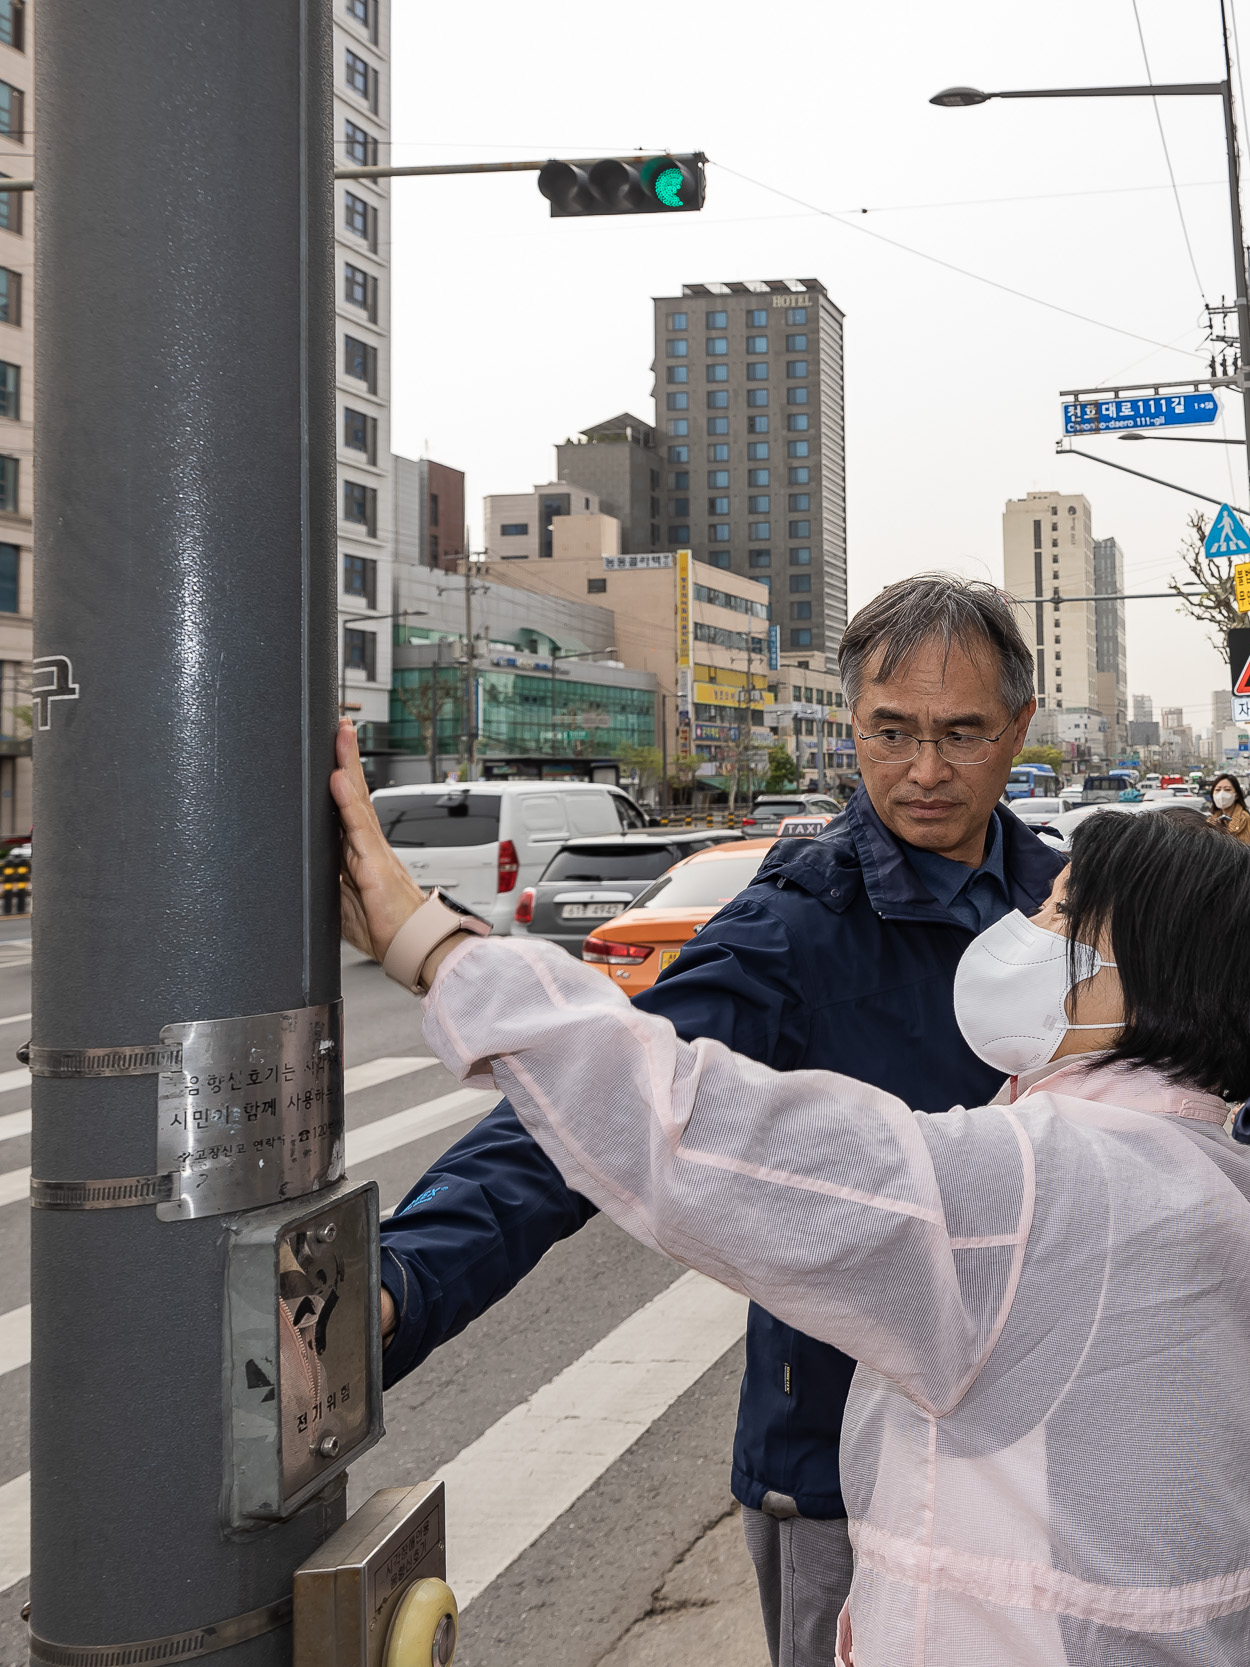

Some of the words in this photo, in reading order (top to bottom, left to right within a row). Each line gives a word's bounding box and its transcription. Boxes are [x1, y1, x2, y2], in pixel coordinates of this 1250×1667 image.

[772, 294, 813, 308] HOTEL
[787, 823, 822, 836] TAXI
[184, 1063, 296, 1096] 음향신호기는
[243, 1097, 277, 1122] 함께
[194, 1142, 247, 1161] 고장신고
[296, 1383, 351, 1434] 전기위험
[391, 1538, 427, 1591] 음향신호기
